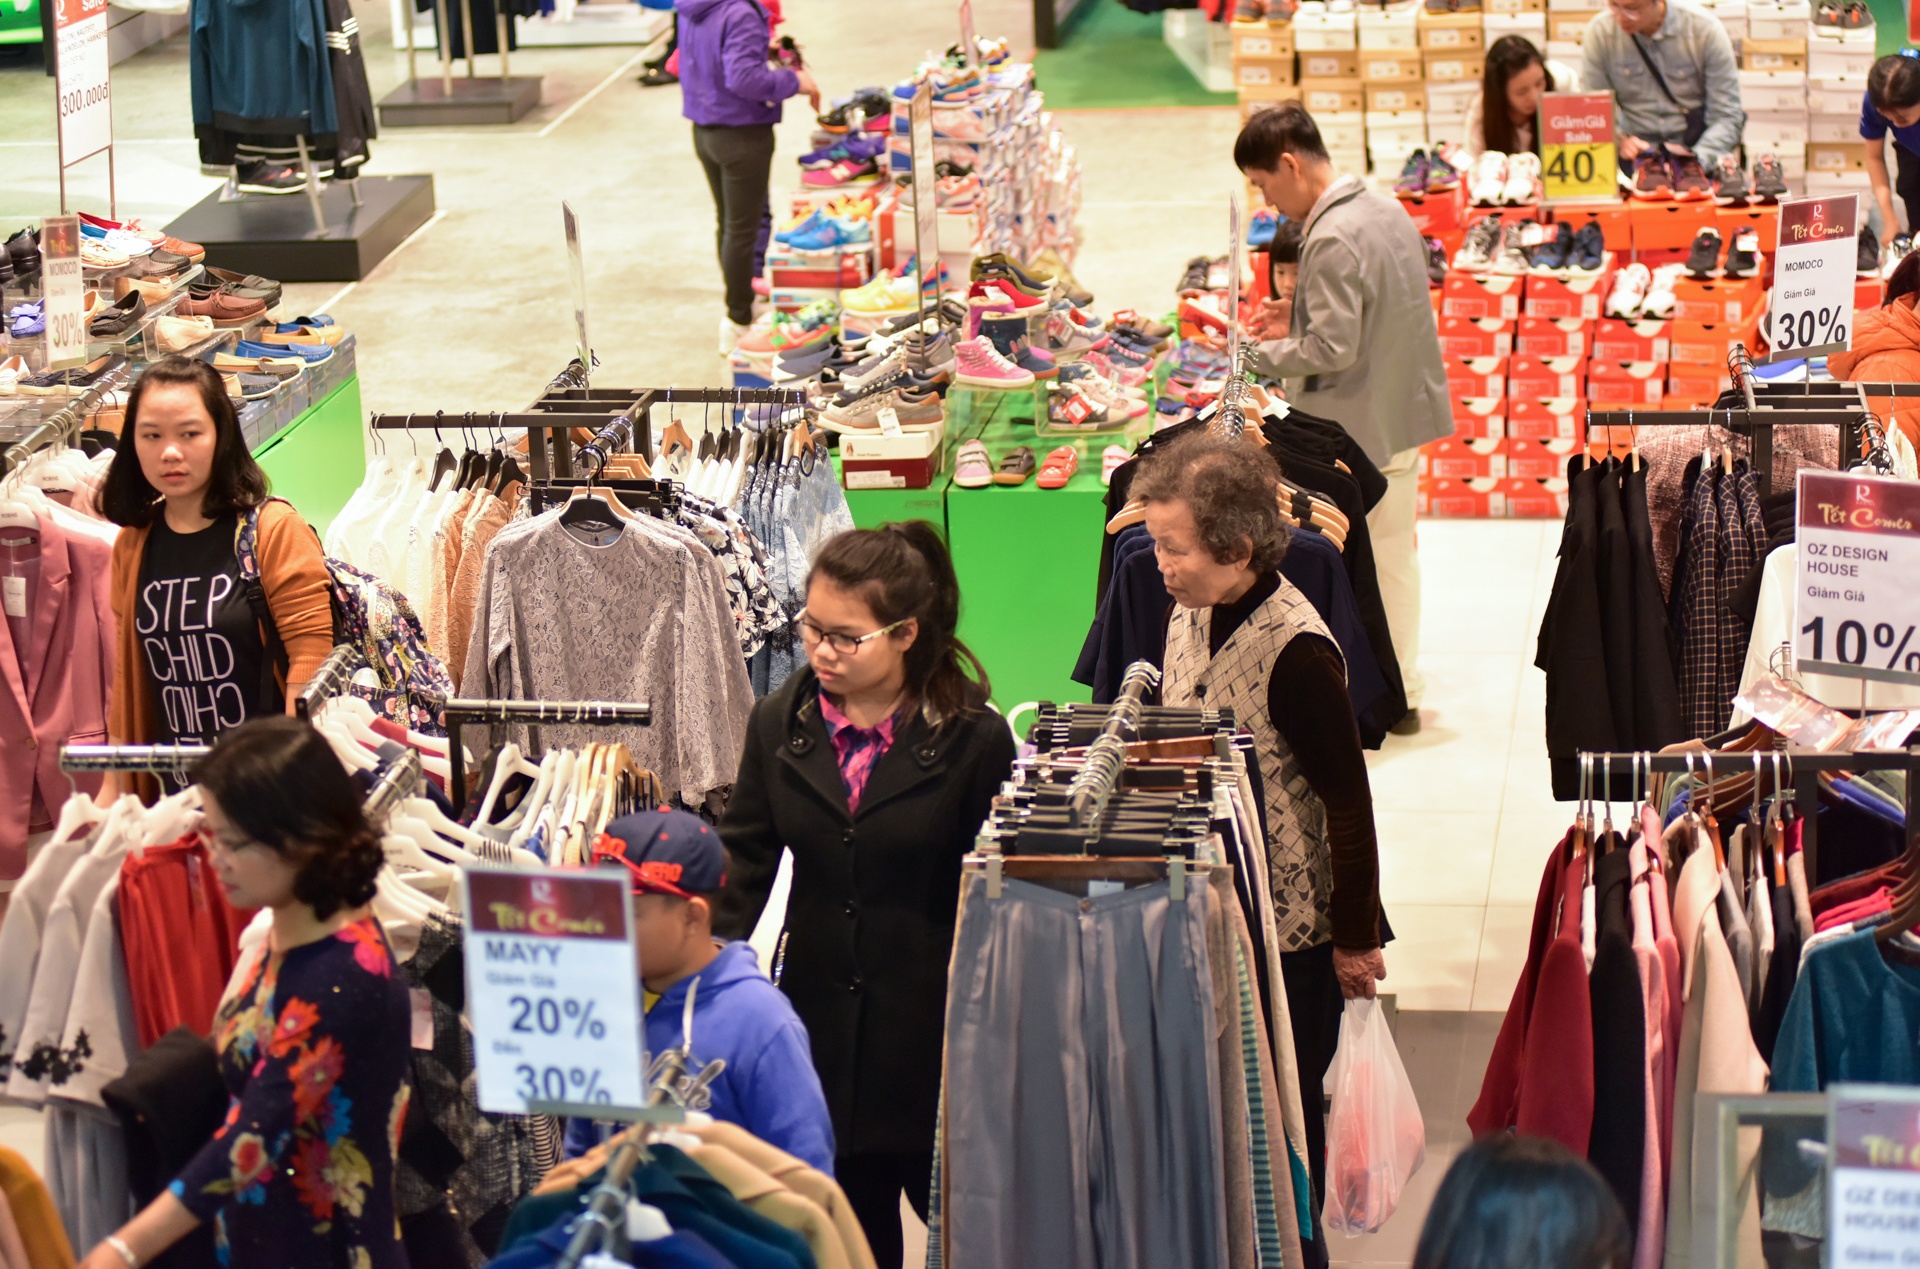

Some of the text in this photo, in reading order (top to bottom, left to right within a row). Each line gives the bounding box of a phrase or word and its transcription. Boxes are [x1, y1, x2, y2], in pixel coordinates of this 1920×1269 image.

[62, 82, 108, 117] 300.000đ
[1547, 150, 1594, 184] 40
[49, 261, 78, 277] MOMOCO
[1785, 259, 1823, 272] MOMOCO
[1784, 287, 1816, 300] Giảm Giá
[52, 311, 82, 348] 30%
[1777, 305, 1846, 350] 30%
[1850, 508, 1913, 530] Corner
[1807, 543, 1888, 562] OZ DESIGN
[1807, 561, 1859, 577] HOUSE
[136, 574, 232, 634] STEP
[1807, 586, 1865, 602] Giảm Giá
[144, 633, 235, 682] CHILD
[1802, 616, 1920, 672] 10%
[485, 940, 561, 966] MAYY
[509, 994, 606, 1040] 20%
[516, 1064, 611, 1105] 30%
